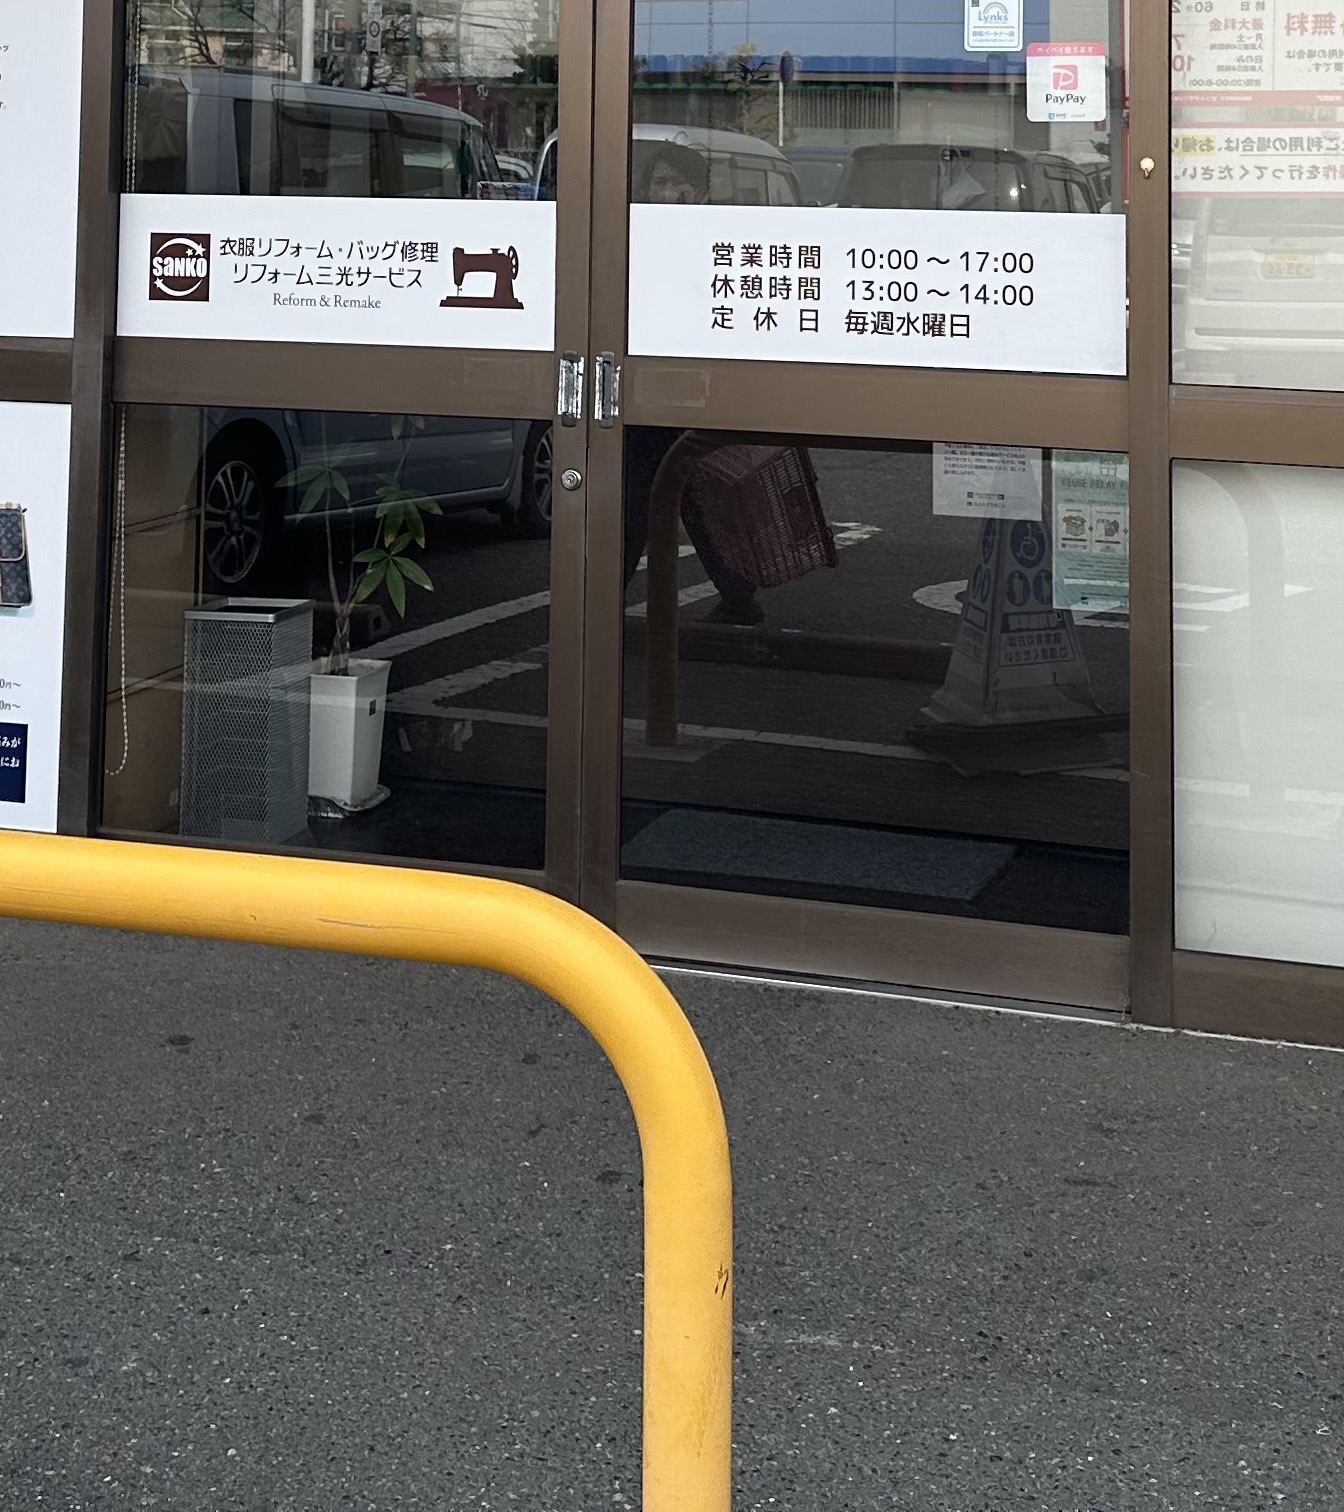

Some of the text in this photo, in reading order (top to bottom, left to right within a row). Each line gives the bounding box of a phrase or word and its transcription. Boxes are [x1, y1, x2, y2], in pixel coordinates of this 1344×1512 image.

[978, 10, 1009, 24] Lynks
[1045, 93, 1086, 105] PayPay
[219, 236, 440, 263] 衣服リフォーム・バッグ修理
[711, 242, 822, 270] 営業時間
[233, 263, 423, 289] リフォーム三光サービス
[710, 273, 822, 301] 休憩時間
[273, 292, 382, 310] Reform & Remake
[845, 309, 972, 339] 毎週水曜日
